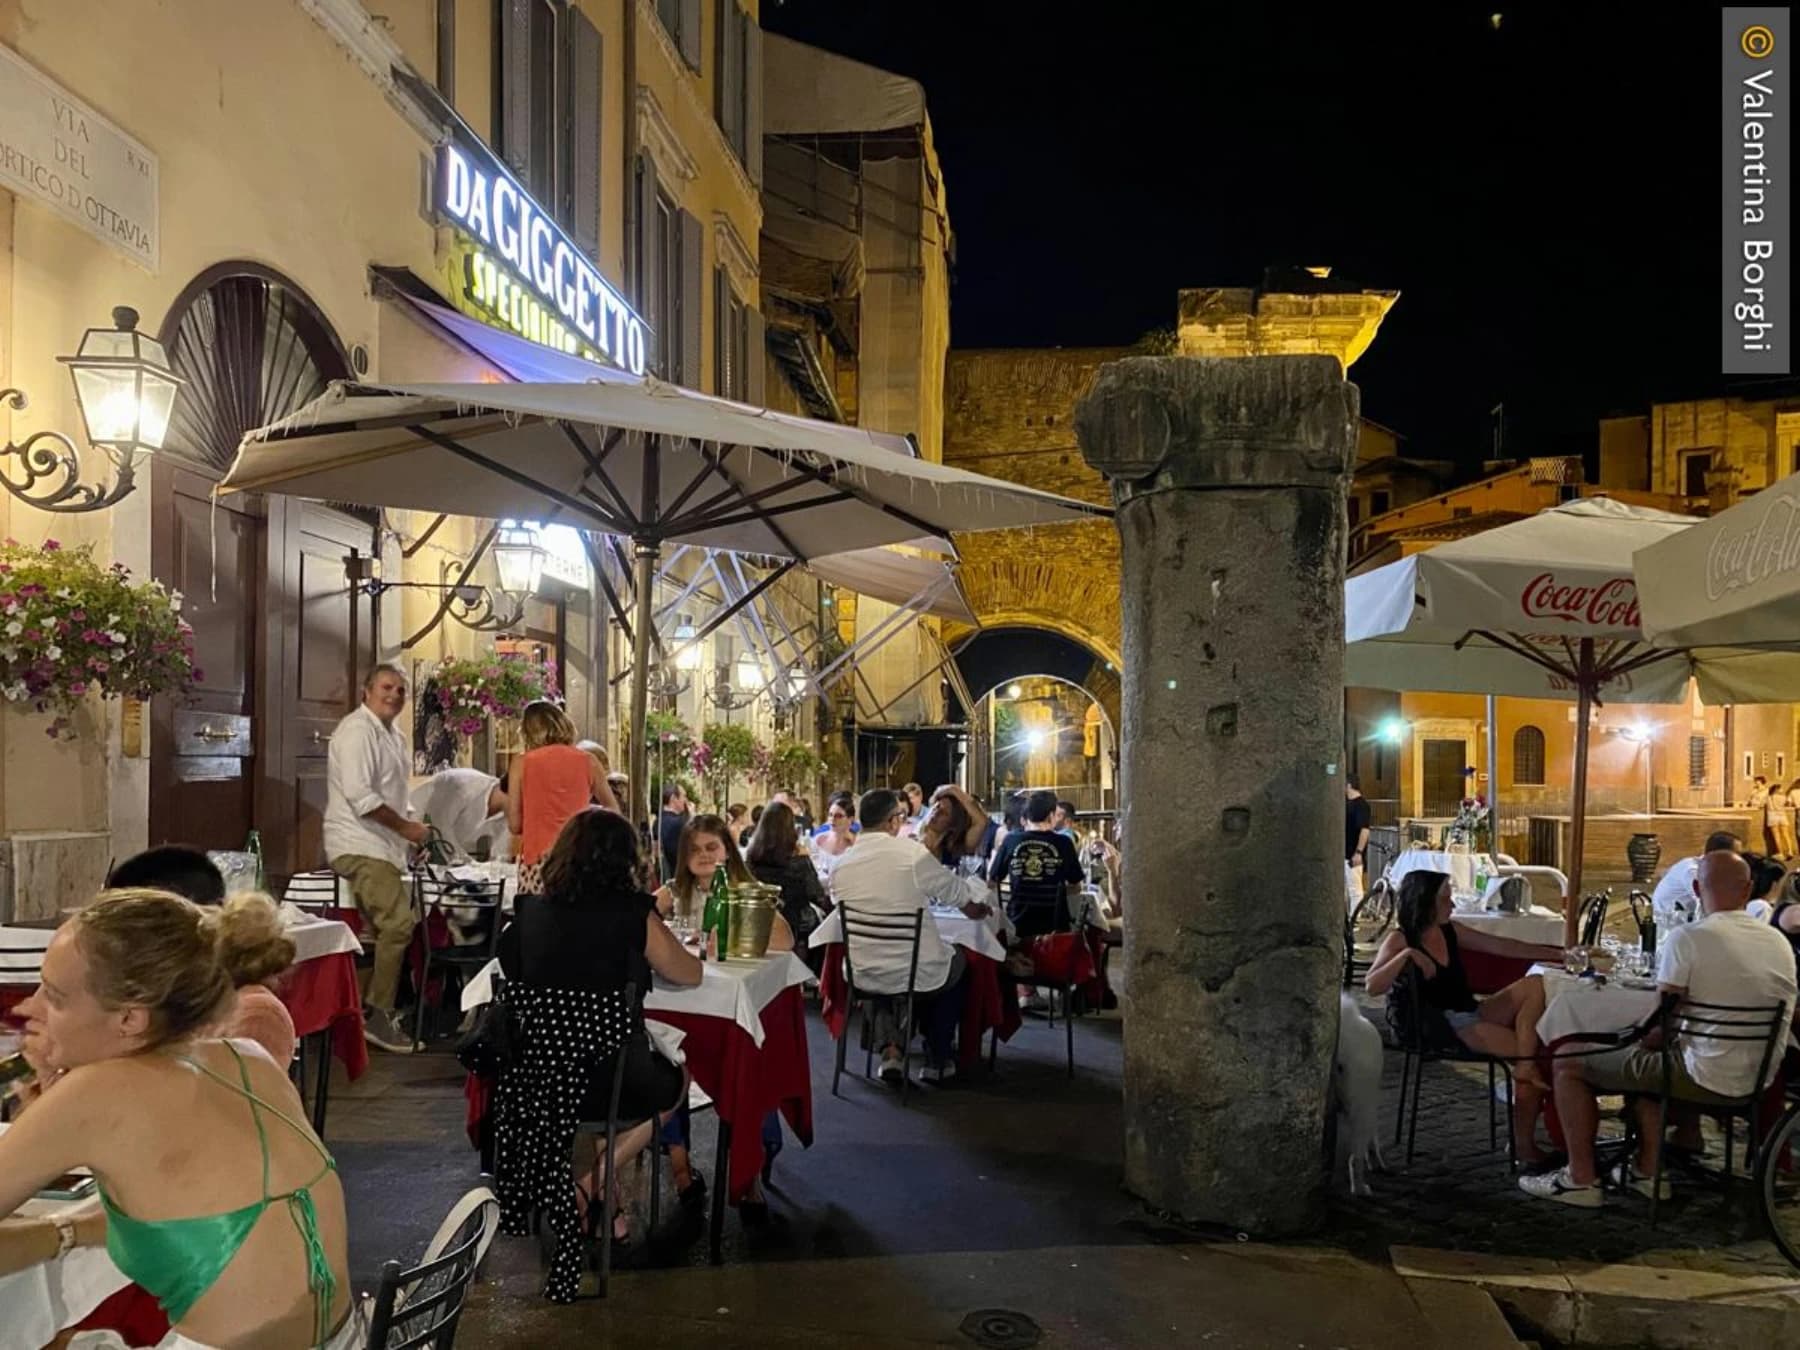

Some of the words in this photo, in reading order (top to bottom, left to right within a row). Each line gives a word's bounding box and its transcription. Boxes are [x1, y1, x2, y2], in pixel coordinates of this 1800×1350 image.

[51, 97, 90, 143] VIA
[0, 141, 64, 199] RTICO
[54, 137, 90, 180] DEL
[446, 145, 491, 243] DA
[492, 176, 645, 376] GIGGETTO
[1521, 572, 1642, 627] Coca-Col
